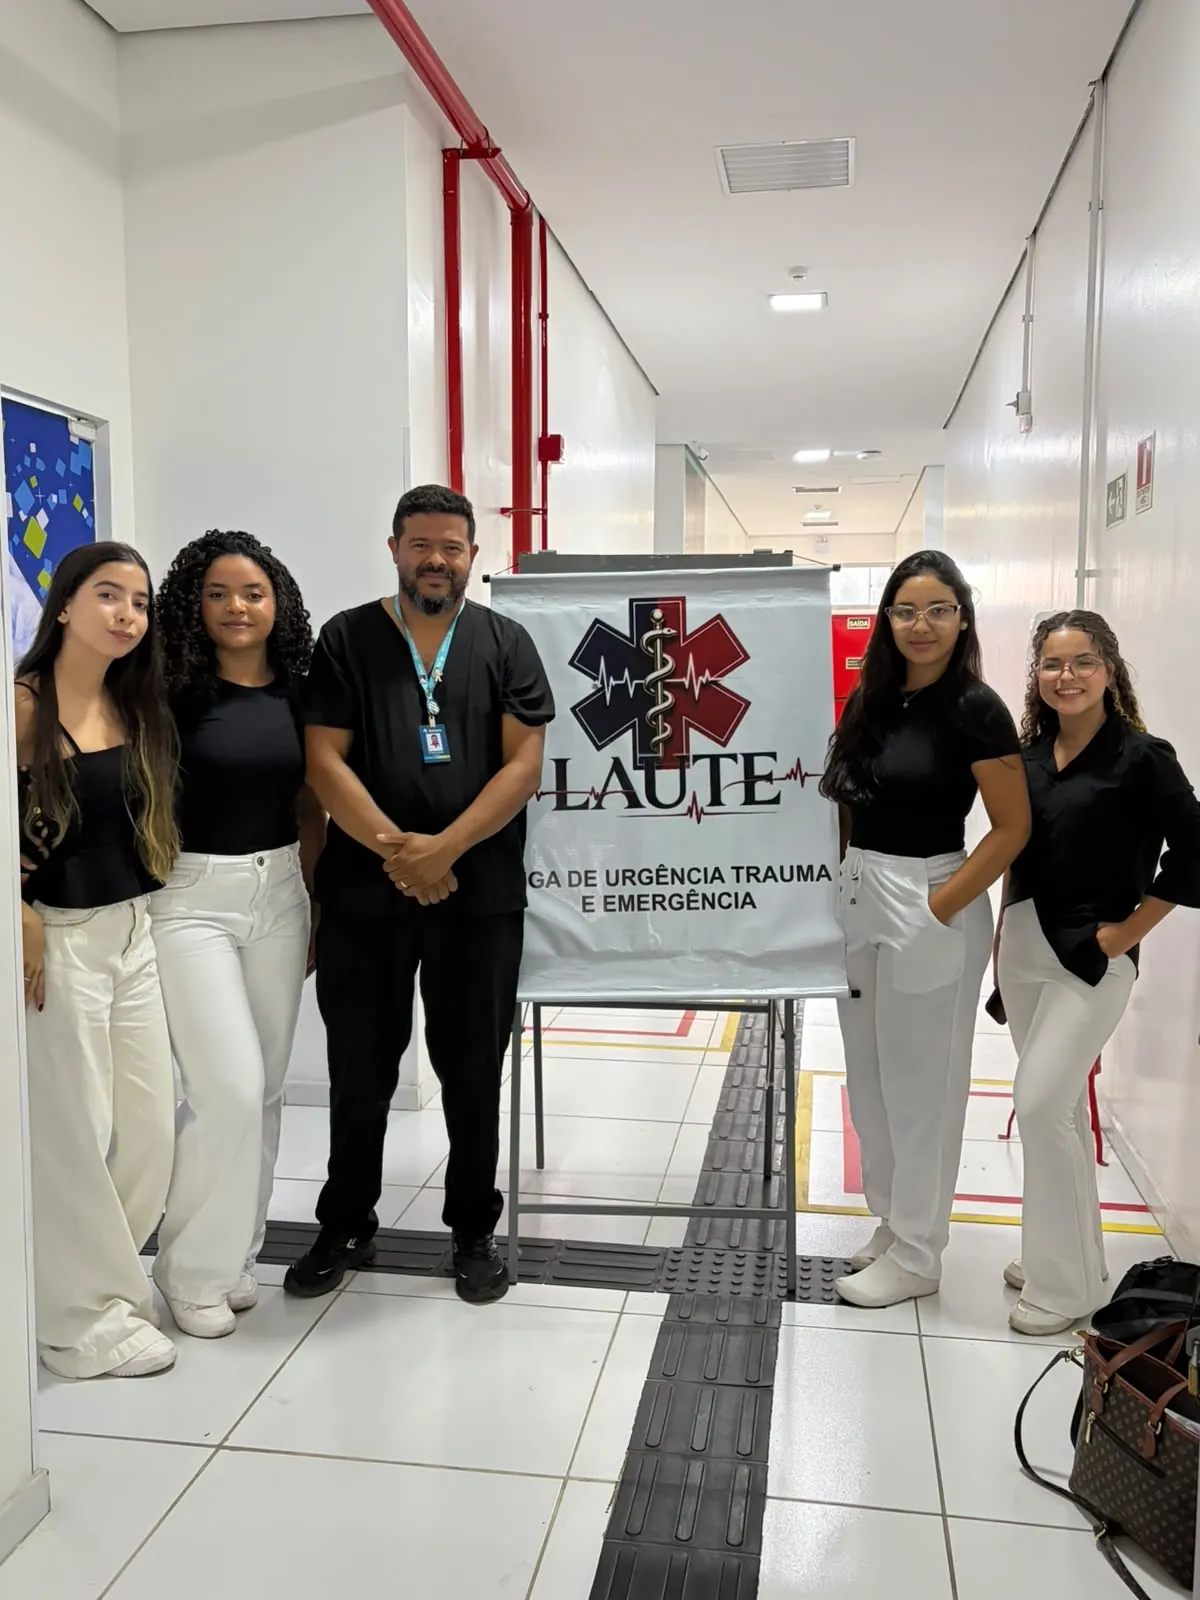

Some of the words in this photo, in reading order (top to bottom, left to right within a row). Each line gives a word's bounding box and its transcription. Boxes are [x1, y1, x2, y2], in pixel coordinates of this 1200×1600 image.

[849, 619, 868, 627] SAÍDA
[550, 752, 781, 811] LAUTE
[527, 870, 562, 889] GA
[567, 869, 598, 888] DE
[605, 864, 726, 887] URGÊNCIA
[731, 864, 832, 884] TRAUMA
[581, 895, 596, 913] E
[603, 889, 757, 912] EMERGÊNCIA
